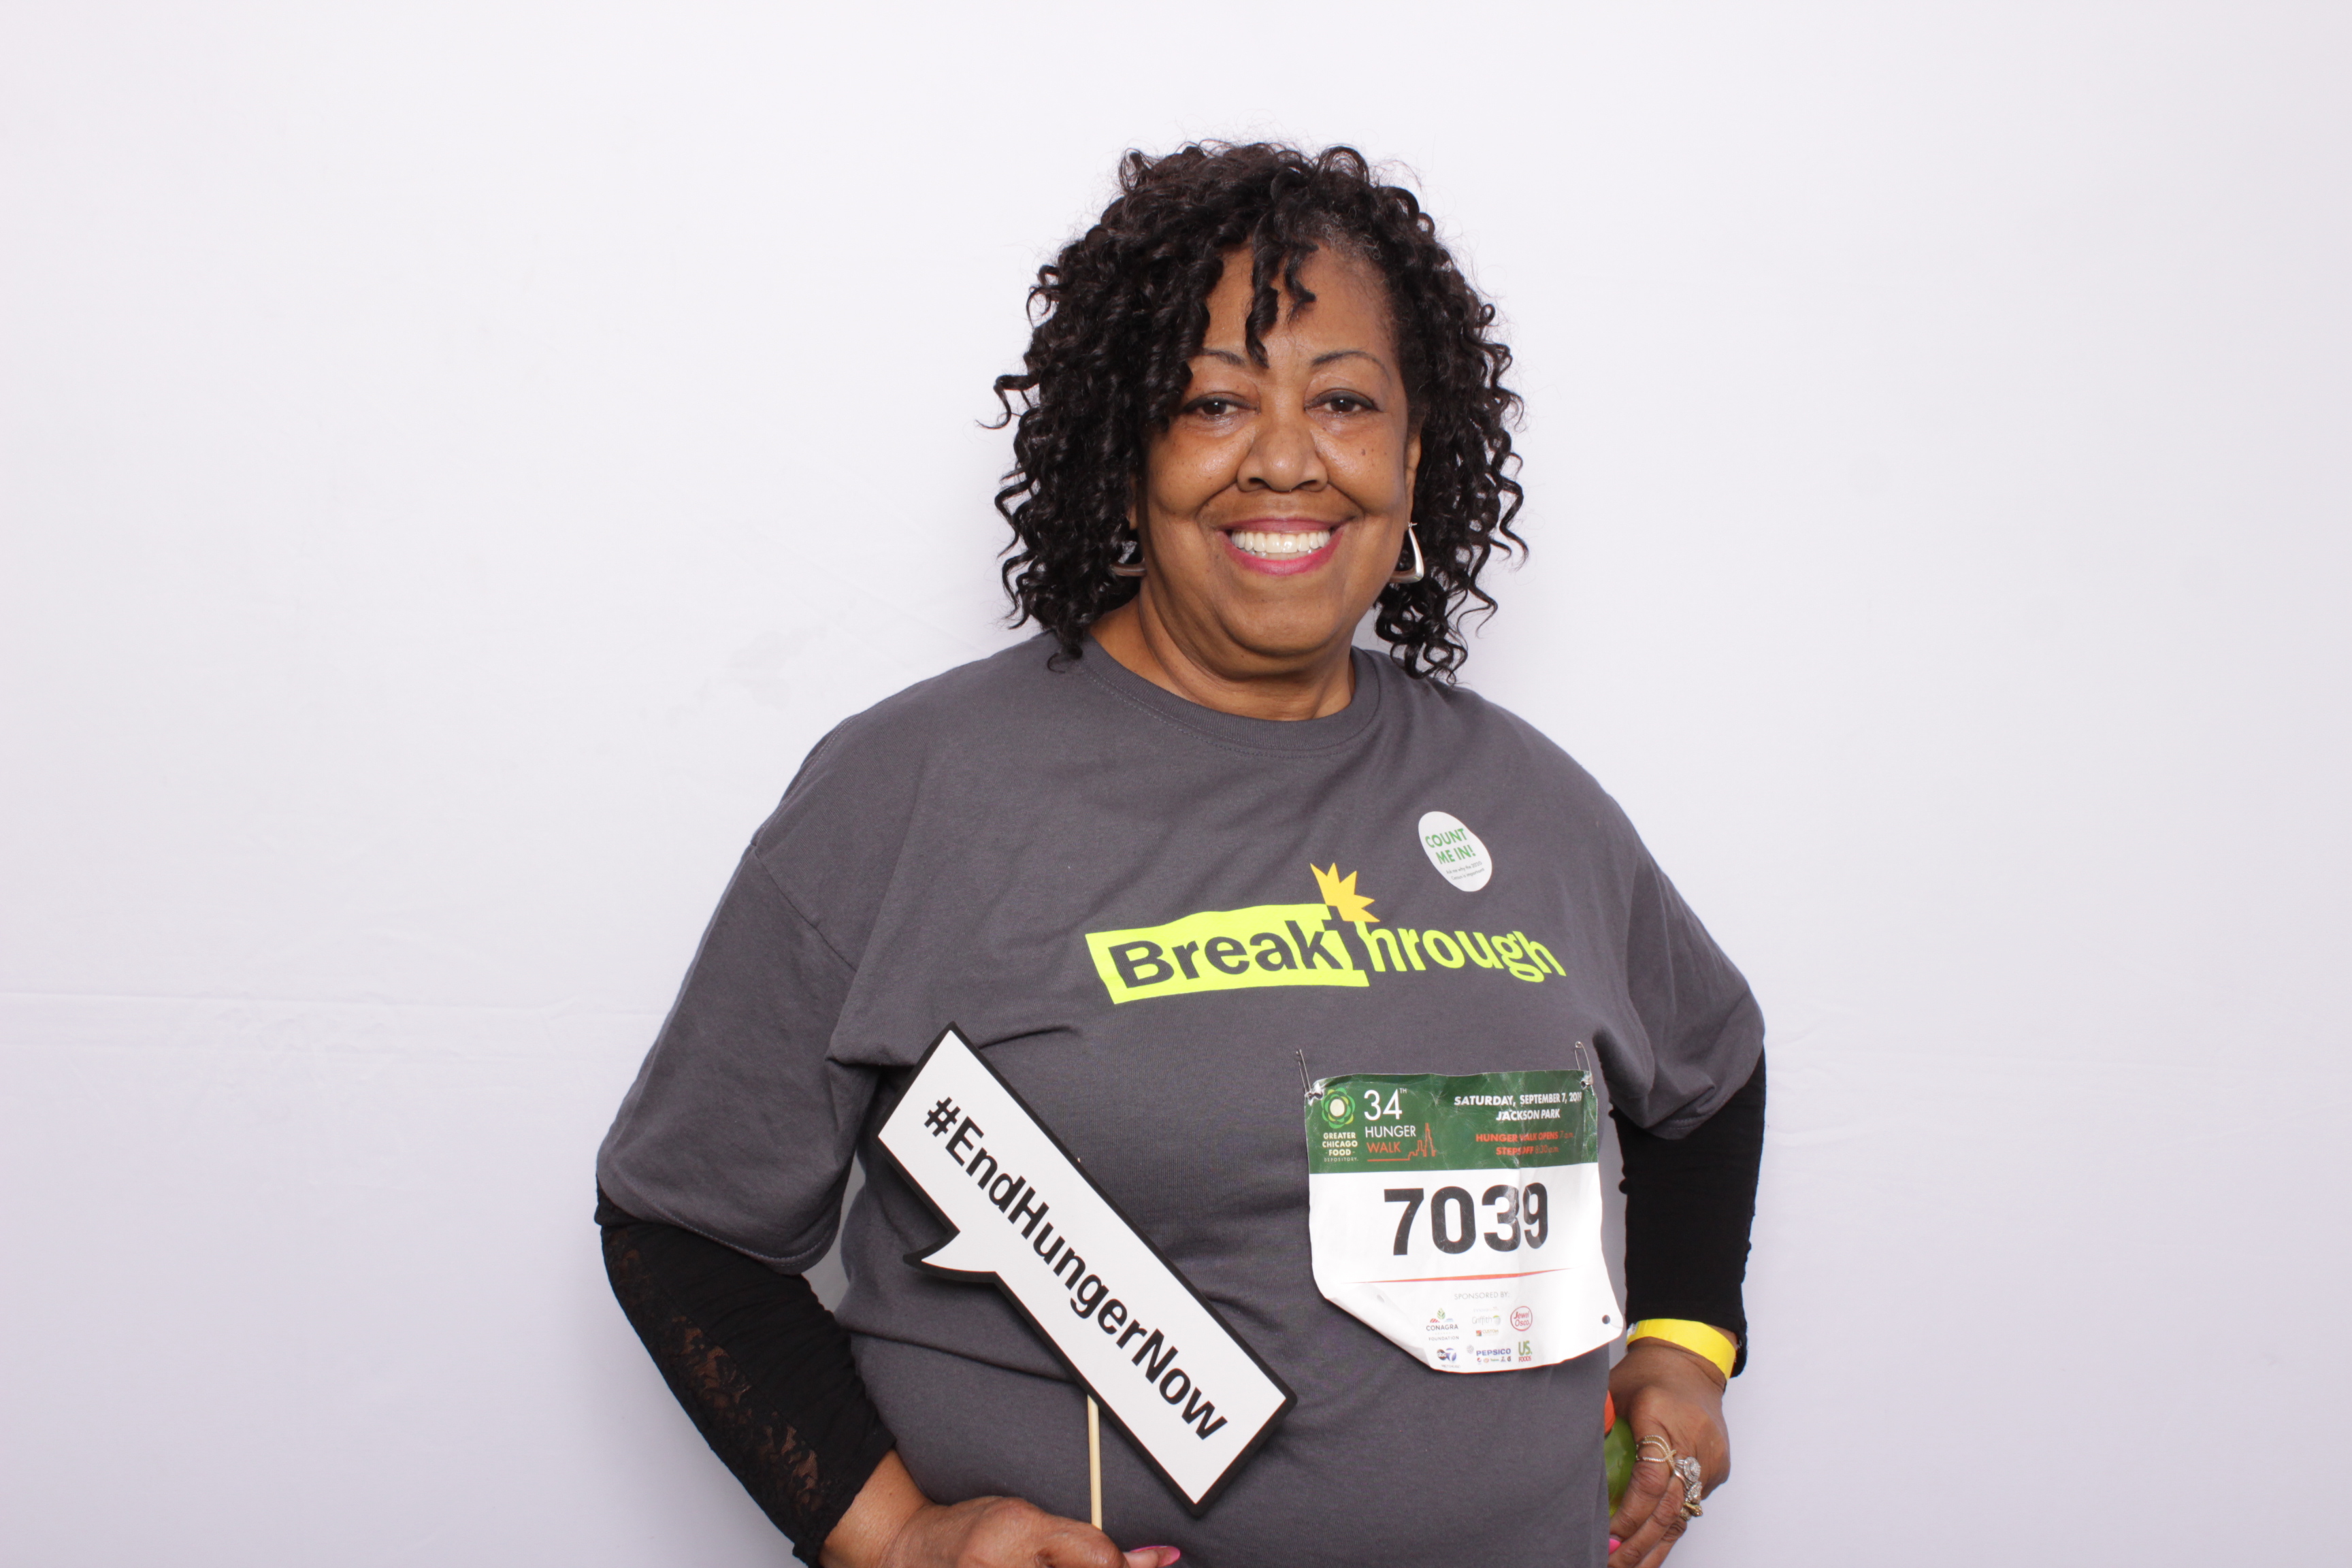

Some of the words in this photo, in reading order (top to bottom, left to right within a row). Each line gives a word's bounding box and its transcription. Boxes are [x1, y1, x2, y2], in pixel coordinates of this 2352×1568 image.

[1425, 828, 1467, 848] COUNT
[1435, 850, 1455, 864] ME
[1454, 845, 1475, 860] IN!
[1466, 868, 1485, 877] important
[1108, 906, 1566, 989] Breakthrough
[1454, 1095, 1516, 1107] SATURDAY,
[1520, 1093, 1561, 1105] SEPTEMBER
[1561, 1093, 1567, 1104] 7,
[1569, 1092, 1582, 1102] 2019
[1496, 1110, 1539, 1121] JACKSON
[1541, 1109, 1561, 1119] PARK
[1365, 1126, 1416, 1137] HUNGER
[1475, 1134, 1518, 1142] HUNGER
[1520, 1132, 1537, 1141] WALK
[1538, 1131, 1558, 1140] OPENS
[1367, 1142, 1402, 1153] WALK
[1384, 1182, 1548, 1256] 7039
[924, 1096, 1228, 1440] #EndHungerNow
[1472, 1316, 1492, 1325] Griffith
[1514, 1311, 1530, 1320] Jewel
[1476, 1348, 1511, 1356] PEPSICO
